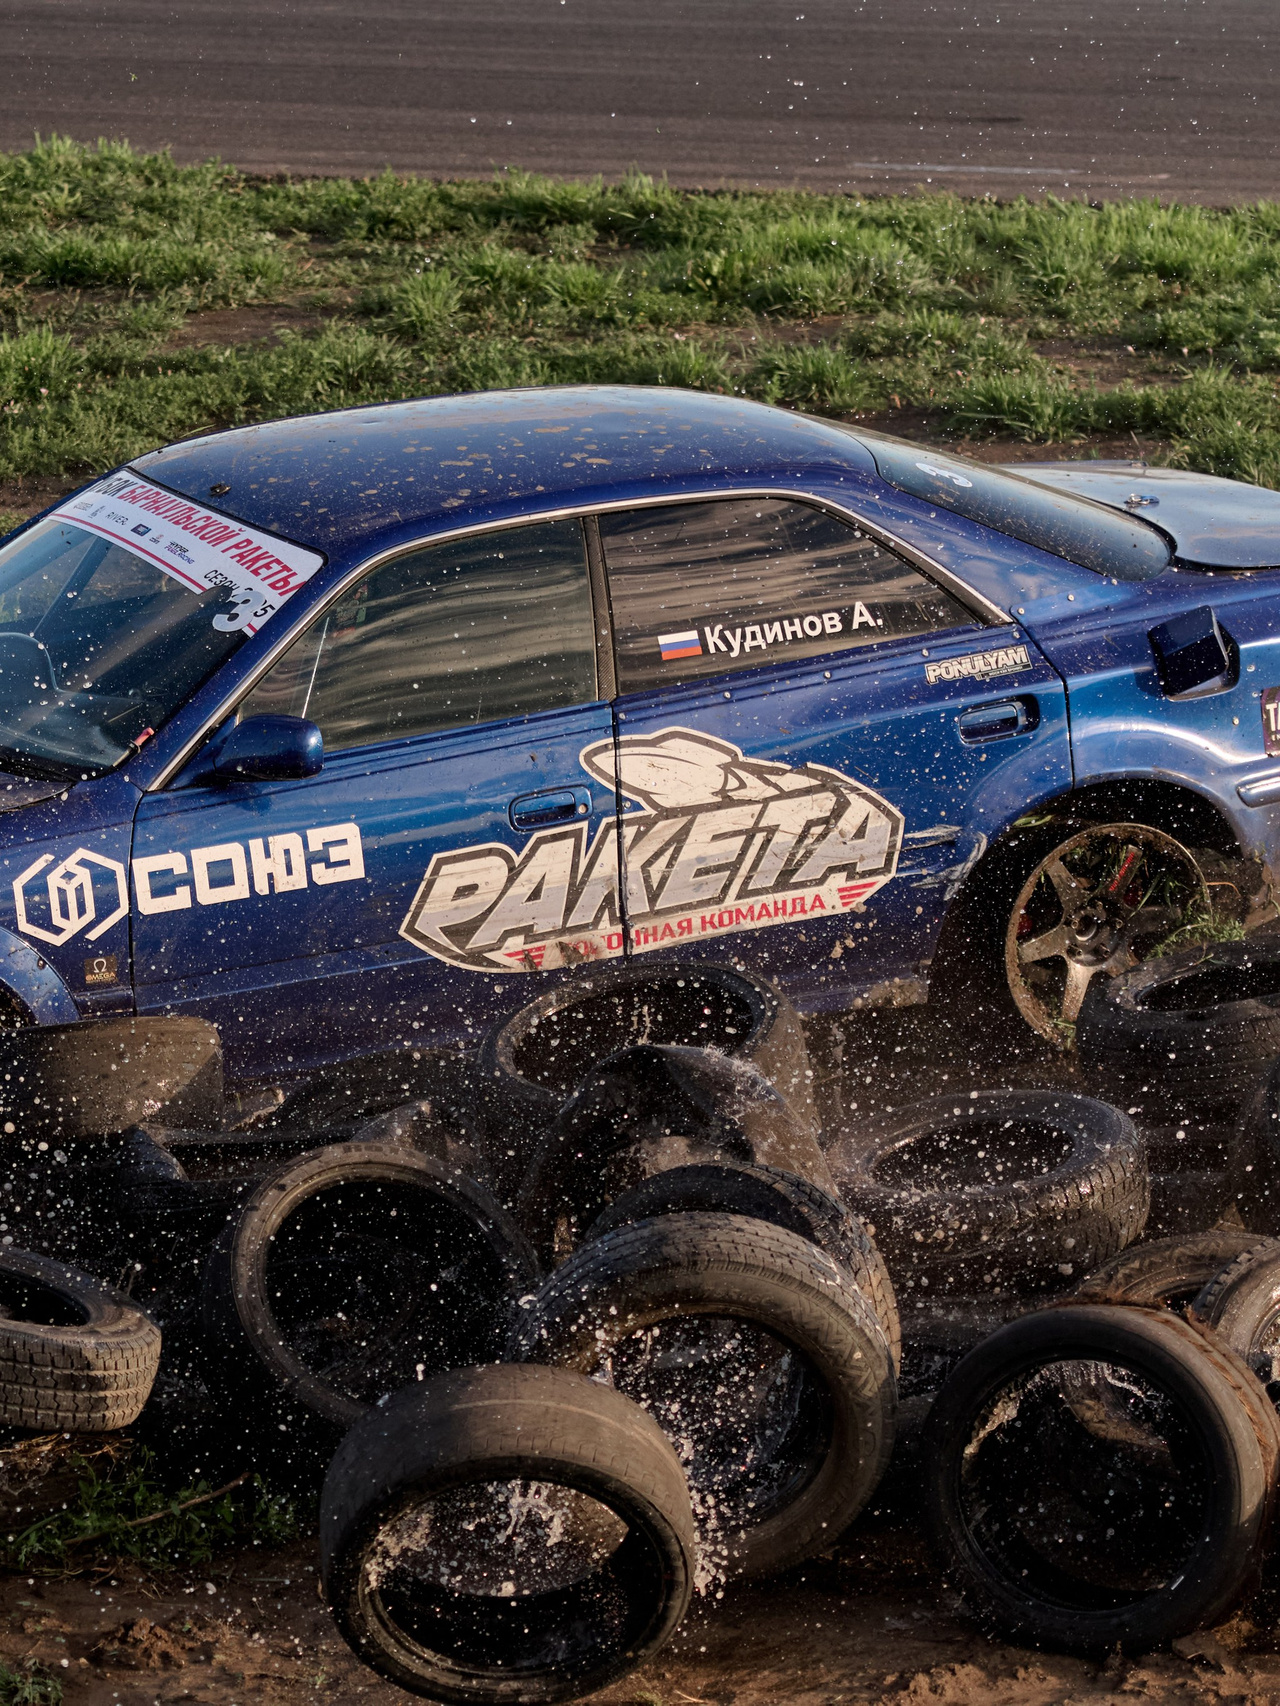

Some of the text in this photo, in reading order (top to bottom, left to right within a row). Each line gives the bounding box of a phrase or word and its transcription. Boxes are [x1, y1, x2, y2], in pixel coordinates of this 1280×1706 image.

[117, 484, 247, 548] БАРНАУЛЬСКОЙ
[221, 538, 308, 597] РАКЕТЫ
[212, 590, 266, 632] 3
[704, 601, 884, 658] Кудинов А.
[926, 646, 1029, 683] PONULYAM
[131, 822, 366, 916] СОЮЗ
[415, 789, 893, 956] РАКЕТА
[701, 893, 827, 933] КОМАНДА
